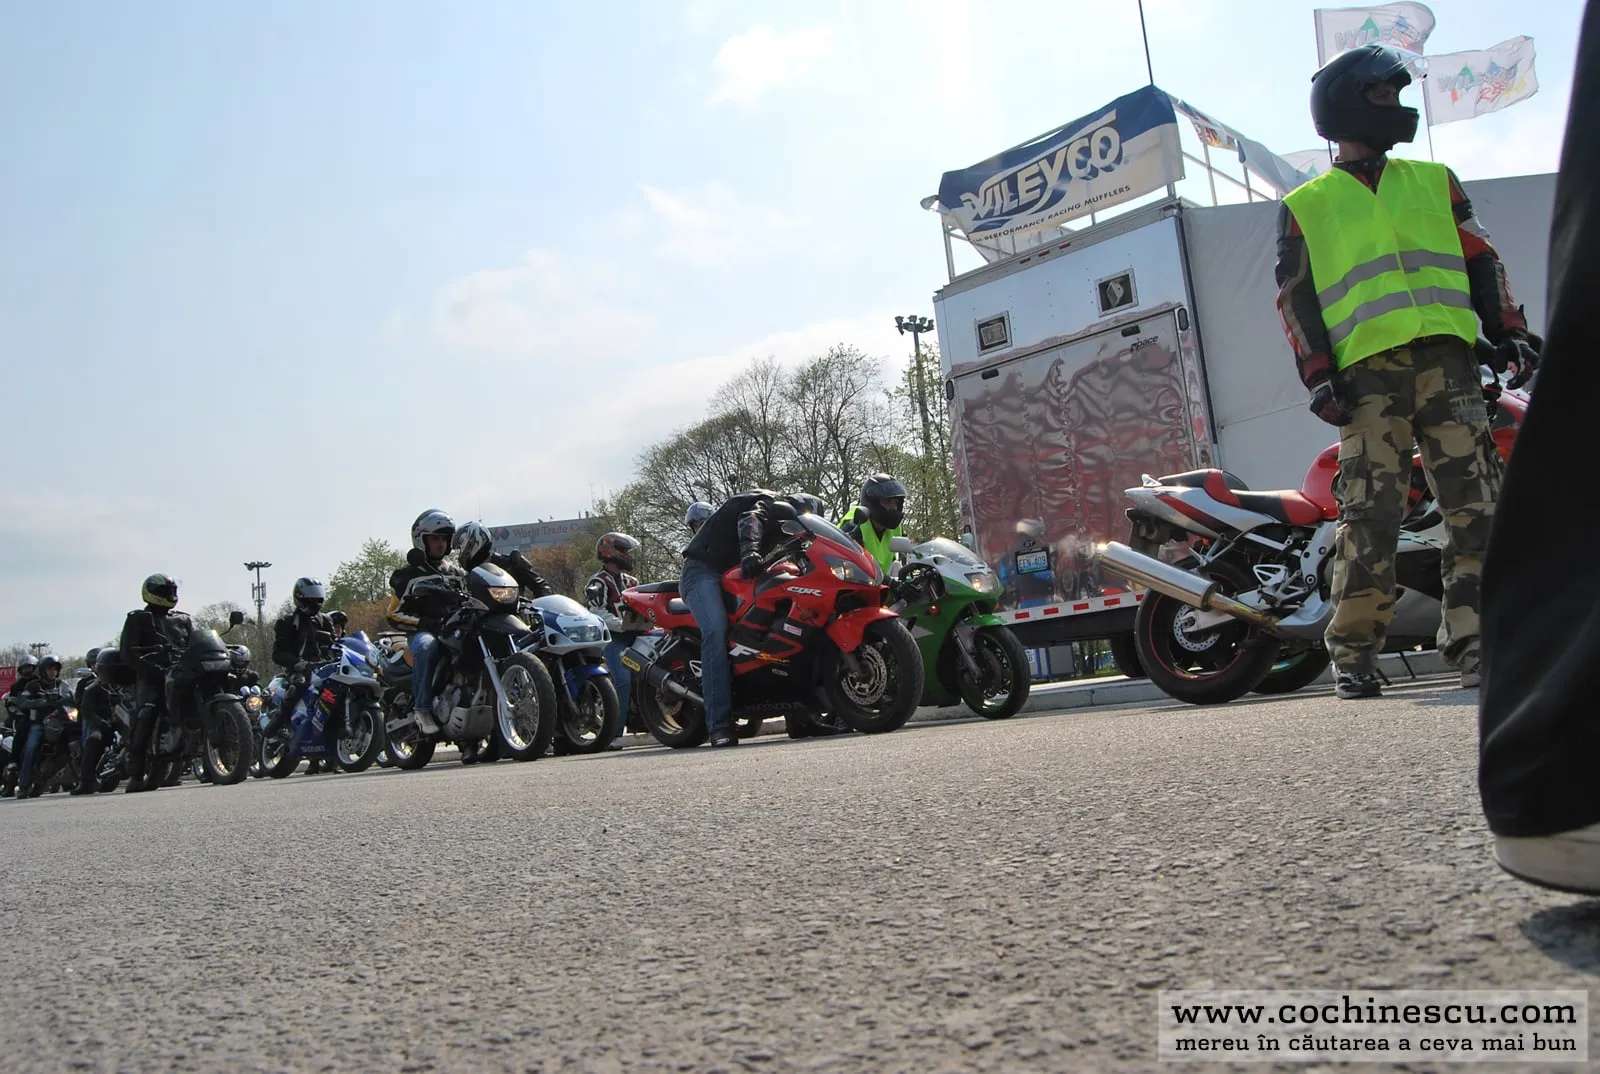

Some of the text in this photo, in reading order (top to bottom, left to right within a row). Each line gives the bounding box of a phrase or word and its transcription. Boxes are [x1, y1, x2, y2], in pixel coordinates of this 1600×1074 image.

[984, 185, 1131, 240] PERFORMANCE RACING MUFFLERS
[513, 527, 540, 538] World
[542, 523, 568, 535] Trade
